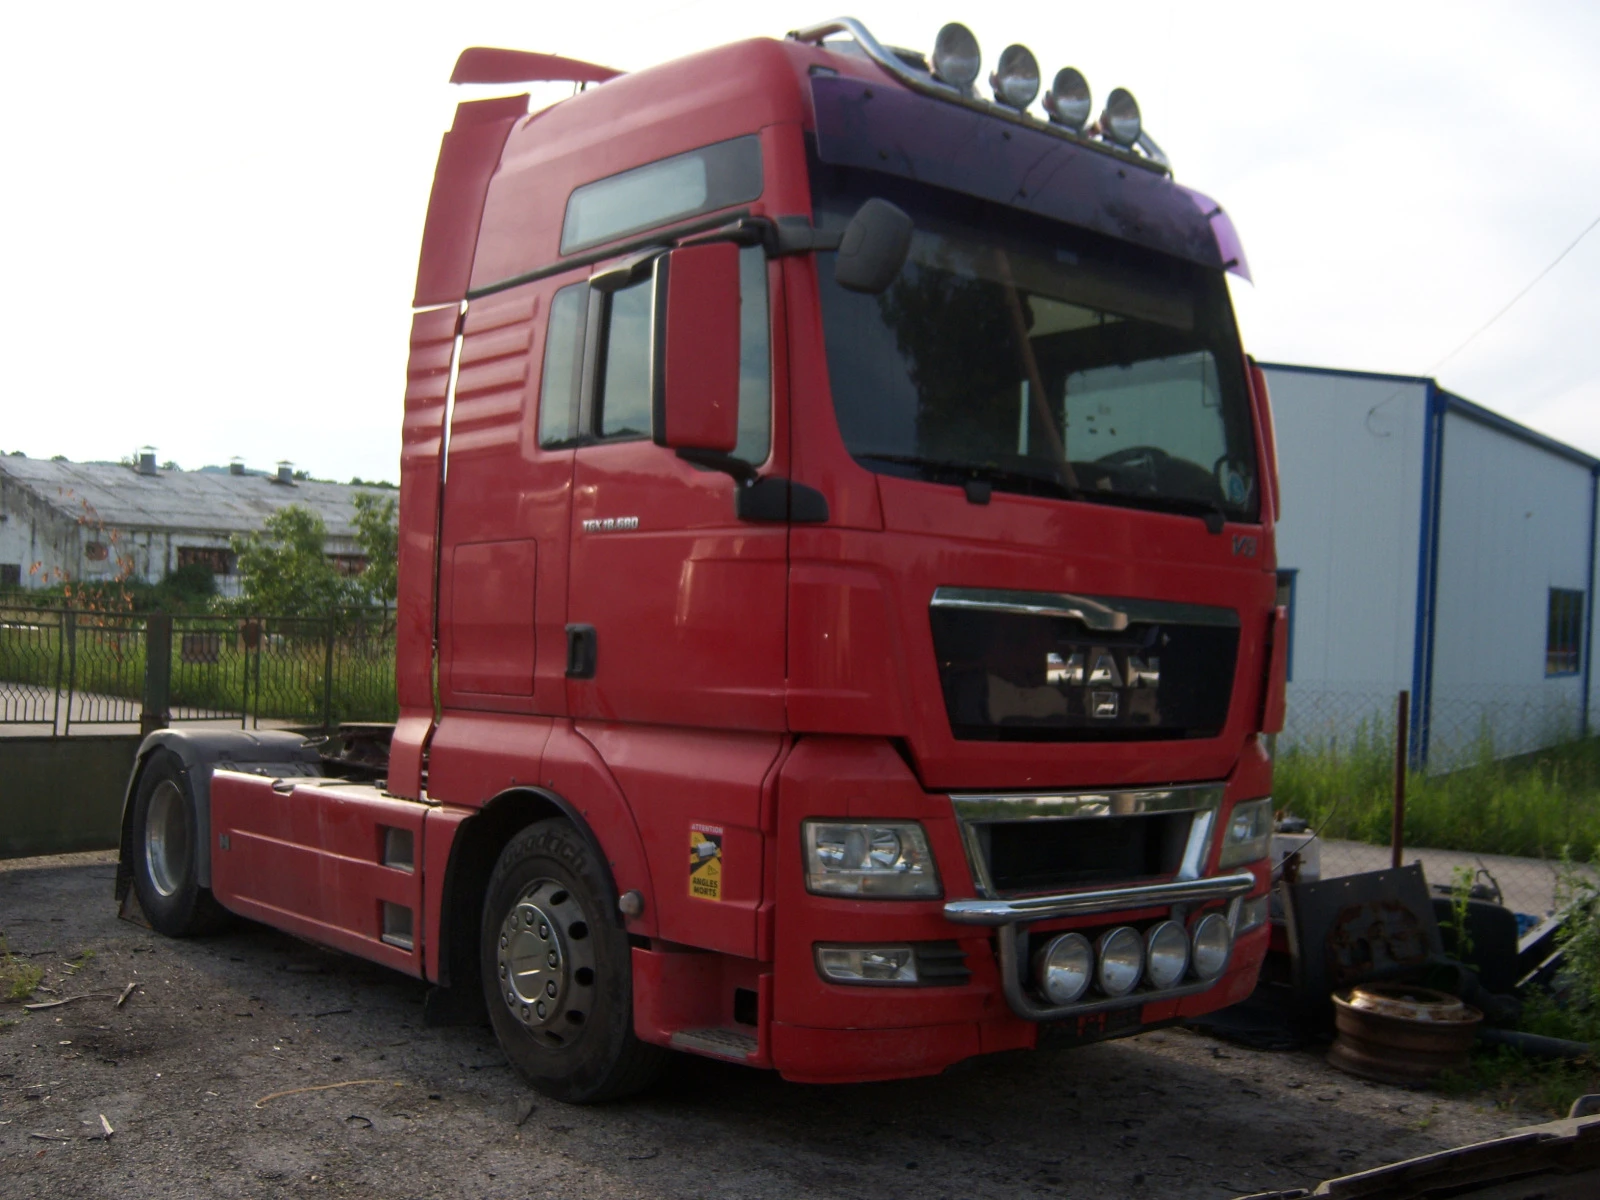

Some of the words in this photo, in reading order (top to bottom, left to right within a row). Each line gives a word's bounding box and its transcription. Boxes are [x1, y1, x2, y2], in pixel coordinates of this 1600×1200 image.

[1046, 651, 1160, 688] MAN
[691, 823, 724, 835] ATTENTION
[692, 876, 719, 889] ANGLES
[693, 885, 718, 898] MORTS
